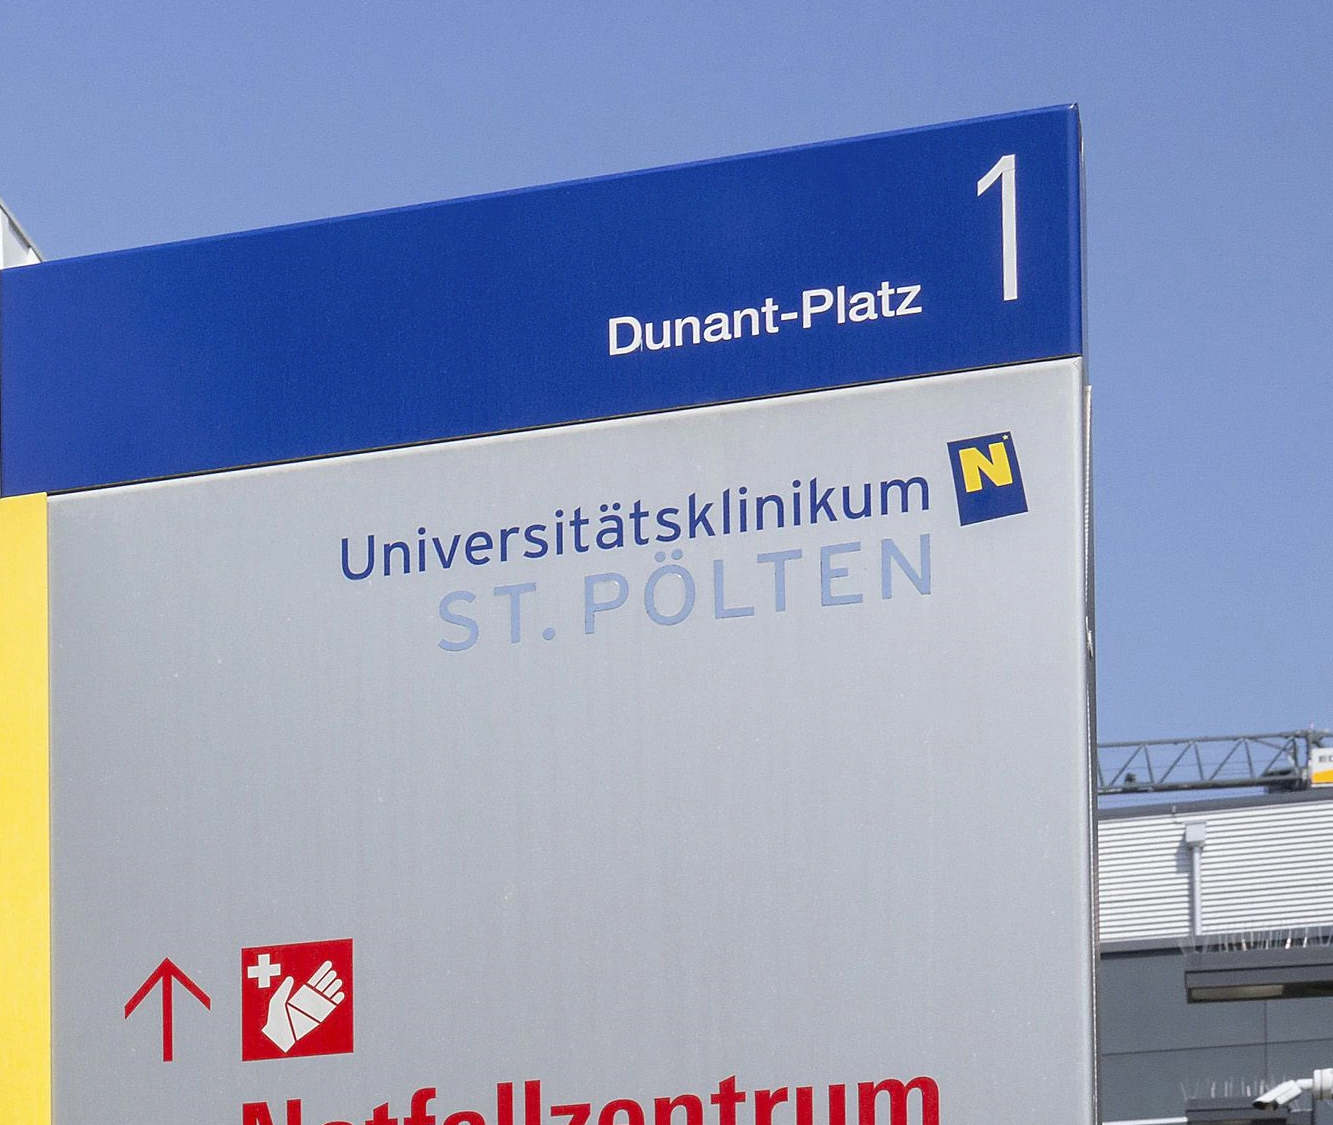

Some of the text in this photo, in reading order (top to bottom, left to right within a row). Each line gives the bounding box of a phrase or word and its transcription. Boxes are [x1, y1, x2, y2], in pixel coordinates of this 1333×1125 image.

[976, 154, 1018, 300] 1
[609, 281, 922, 355] Dunant-Platz
[959, 442, 1013, 492] N
[340, 476, 930, 581] Universitätsklinikum
[437, 533, 931, 653] ST. PÖLTEN
